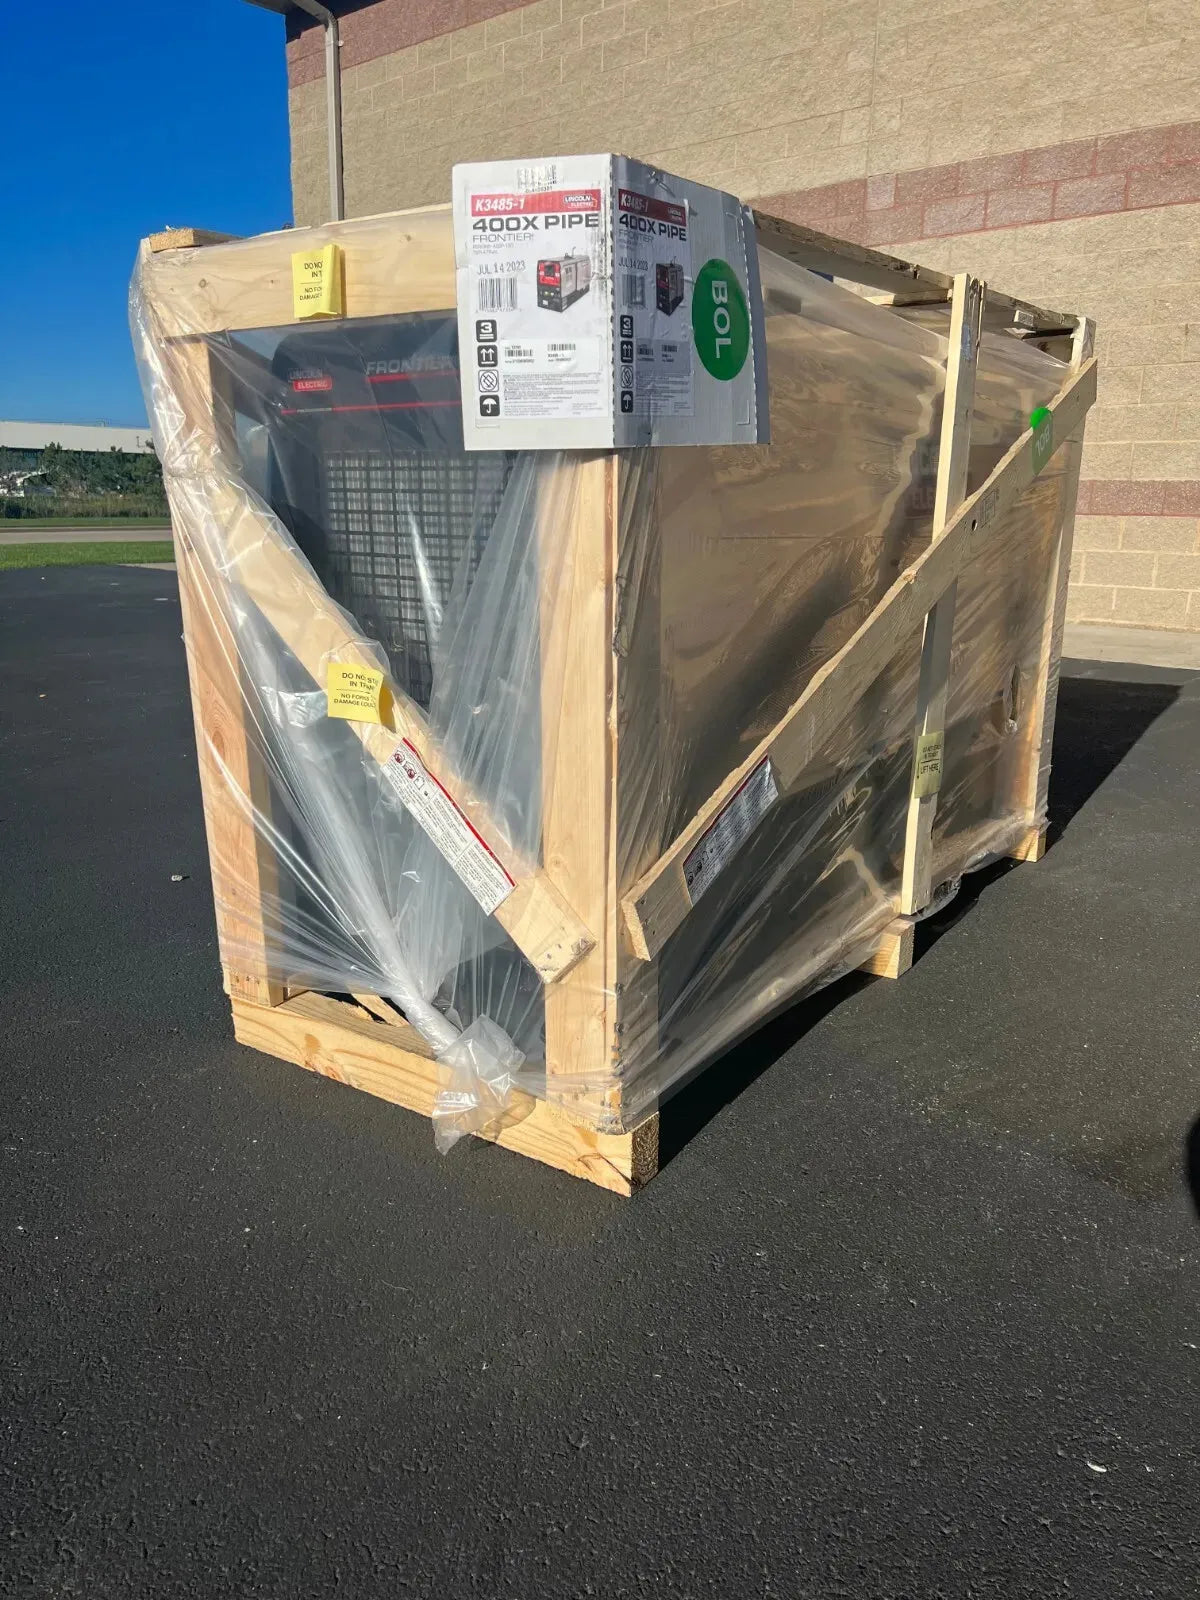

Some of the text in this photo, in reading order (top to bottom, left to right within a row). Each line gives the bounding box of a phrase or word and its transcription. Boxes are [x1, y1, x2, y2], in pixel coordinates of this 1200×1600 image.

[475, 198, 525, 212] K3485-1
[564, 195, 591, 203] LINCOLN
[472, 213, 599, 233] 400X PIPE
[619, 214, 687, 241] 400X PIPE
[314, 260, 323, 269] NO
[477, 264, 492, 275] JUL
[506, 260, 526, 272] 2023
[711, 280, 732, 359] BOL
[333, 698, 360, 706] DAMAGE
